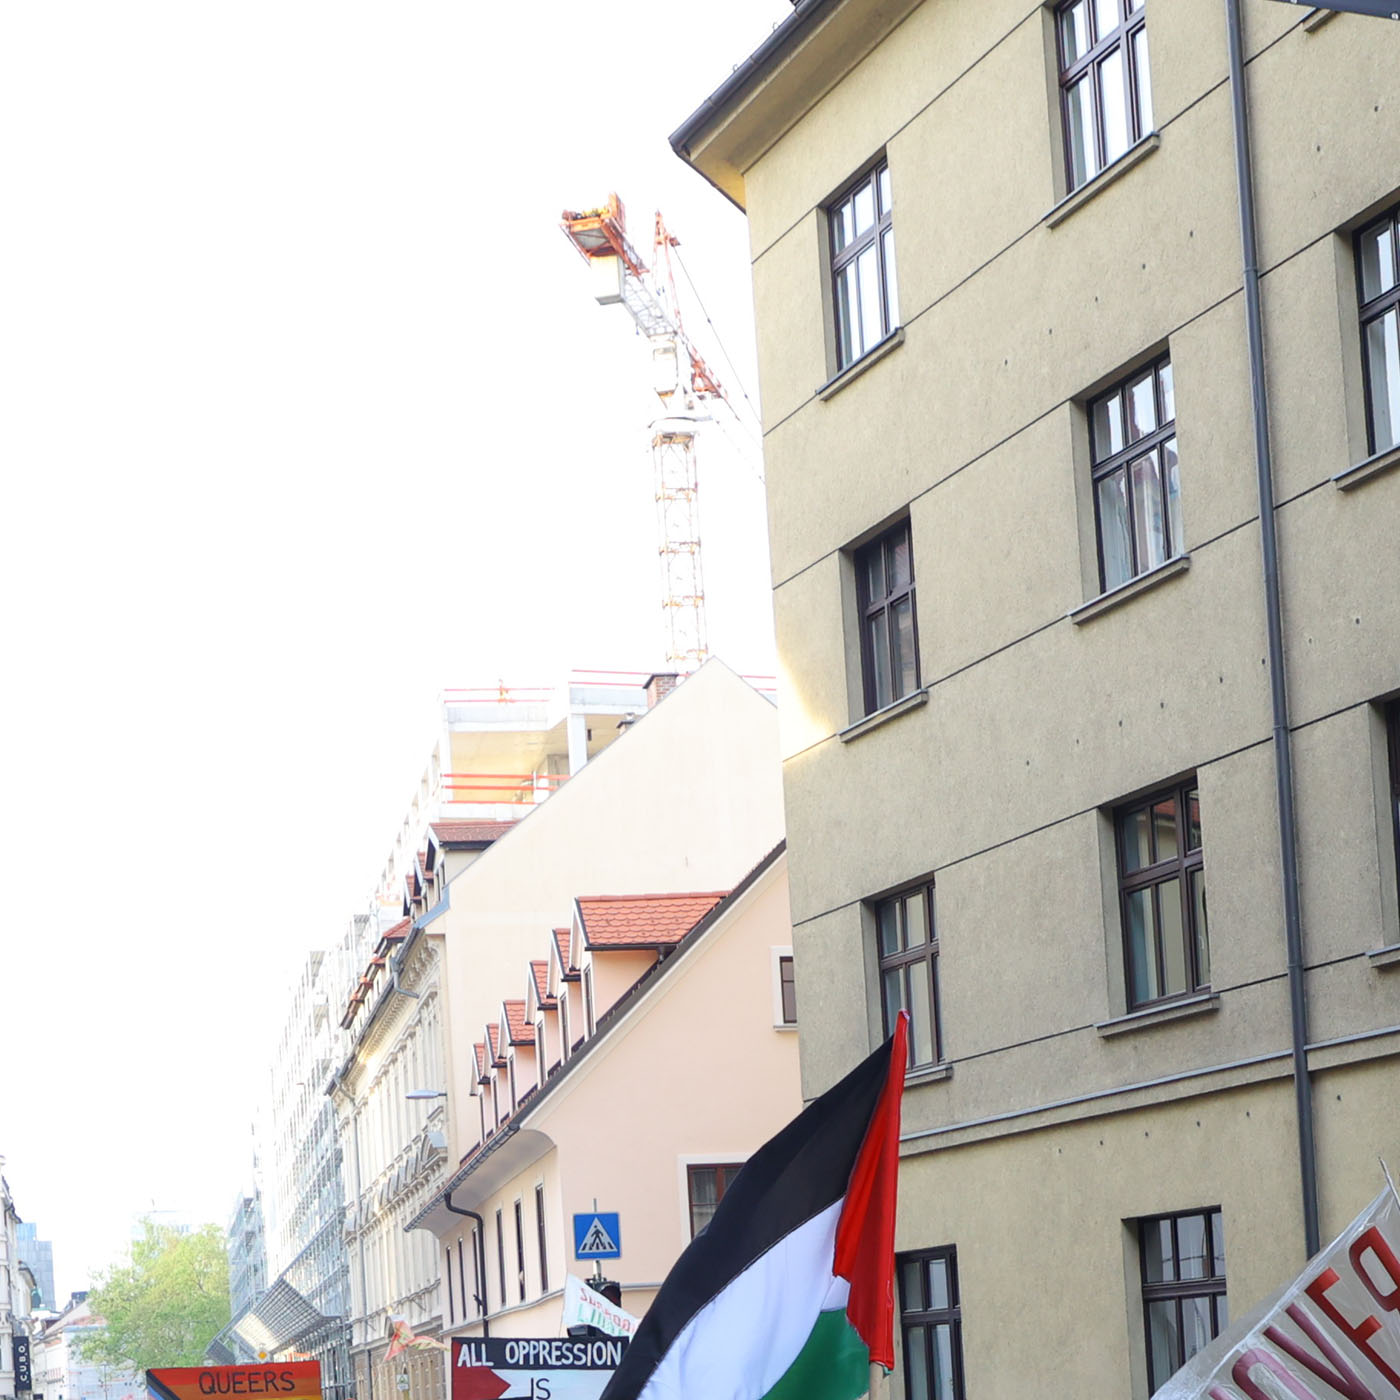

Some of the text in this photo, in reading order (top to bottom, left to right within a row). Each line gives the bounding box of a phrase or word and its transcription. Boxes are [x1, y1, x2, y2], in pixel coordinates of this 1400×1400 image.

[457, 1340, 622, 1368] ALL OPPRESSION
[198, 1371, 296, 1395] QUEERS
[530, 1377, 551, 1400] IS
